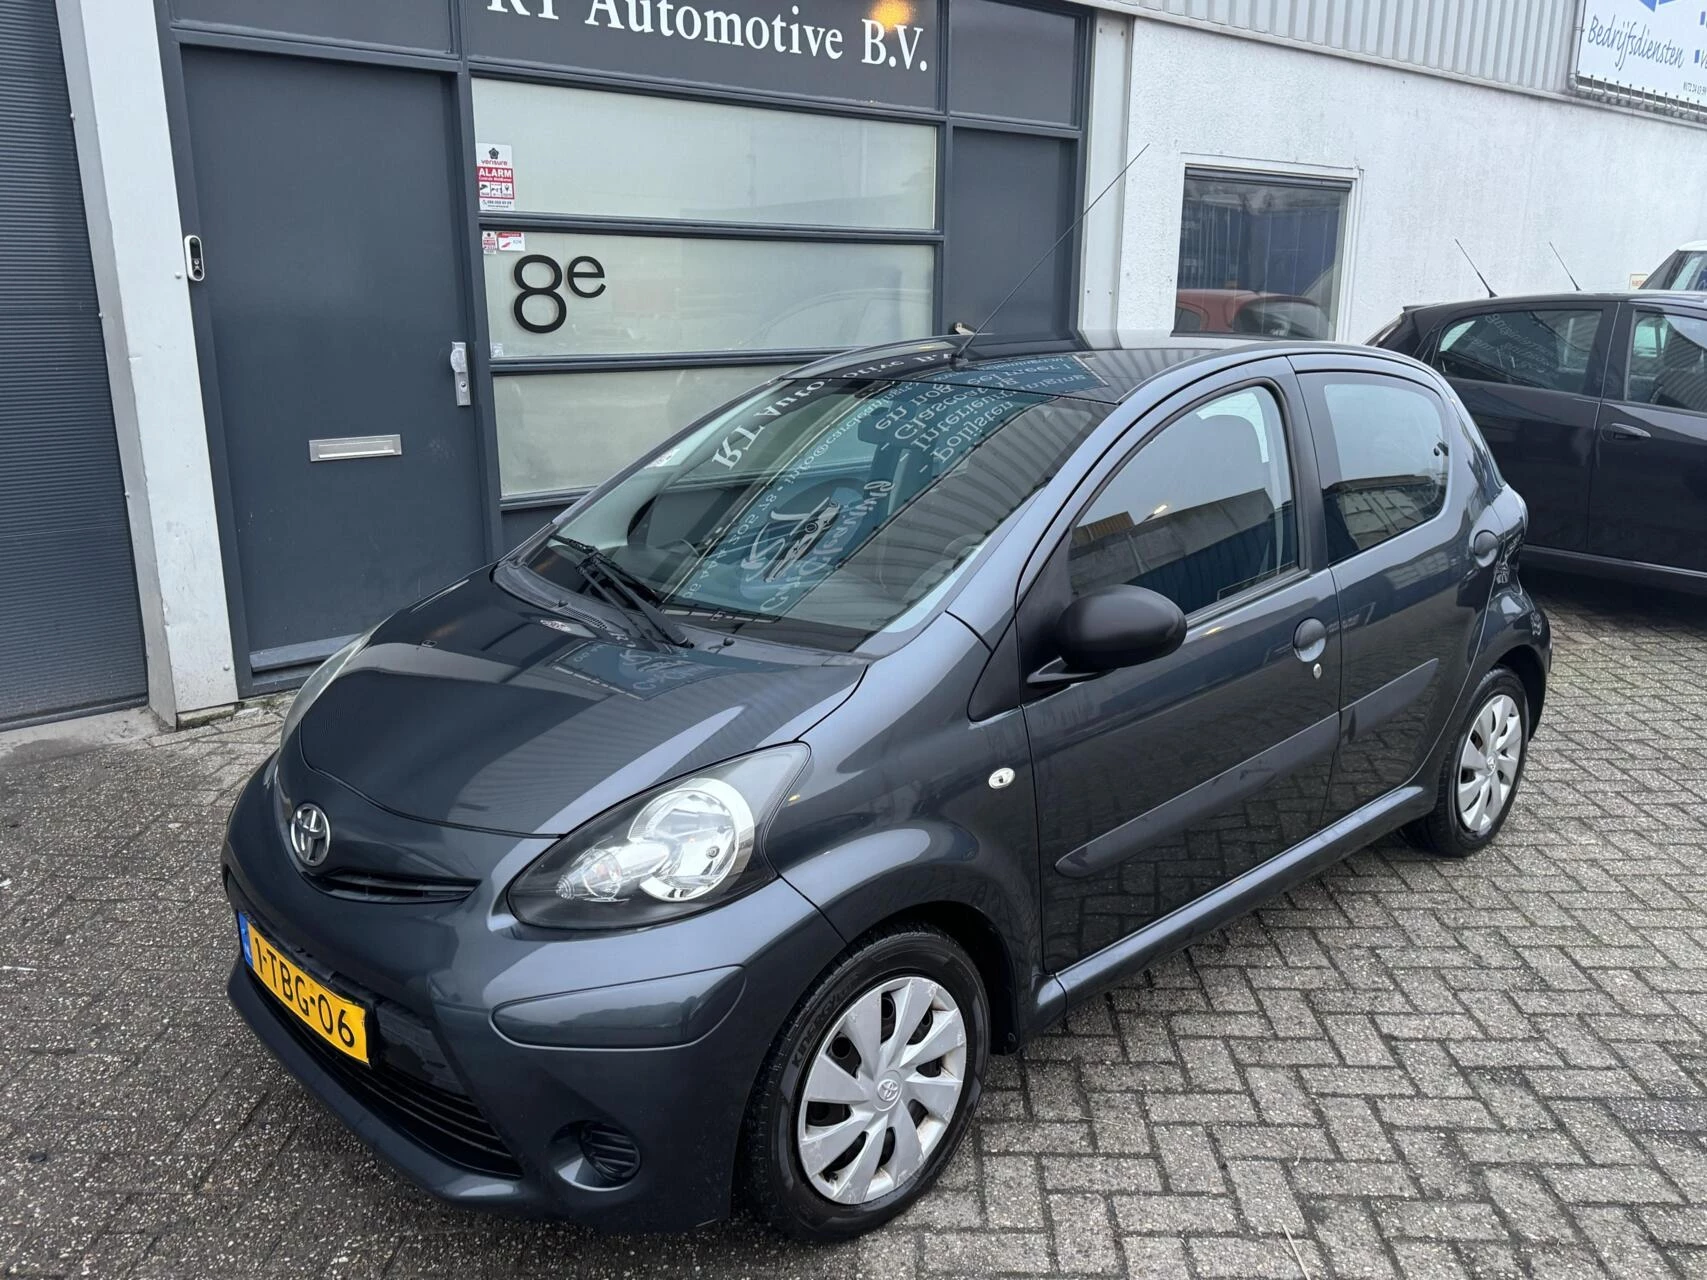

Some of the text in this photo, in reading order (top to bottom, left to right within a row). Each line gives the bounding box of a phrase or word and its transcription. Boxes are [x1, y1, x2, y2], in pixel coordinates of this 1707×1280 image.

[584, 0, 928, 71] Automotive B.V.
[1588, 11, 1684, 72] Bedrijfsdiensten
[479, 167, 512, 178] ALARM
[255, 937, 355, 1048] 1-TBG-06
